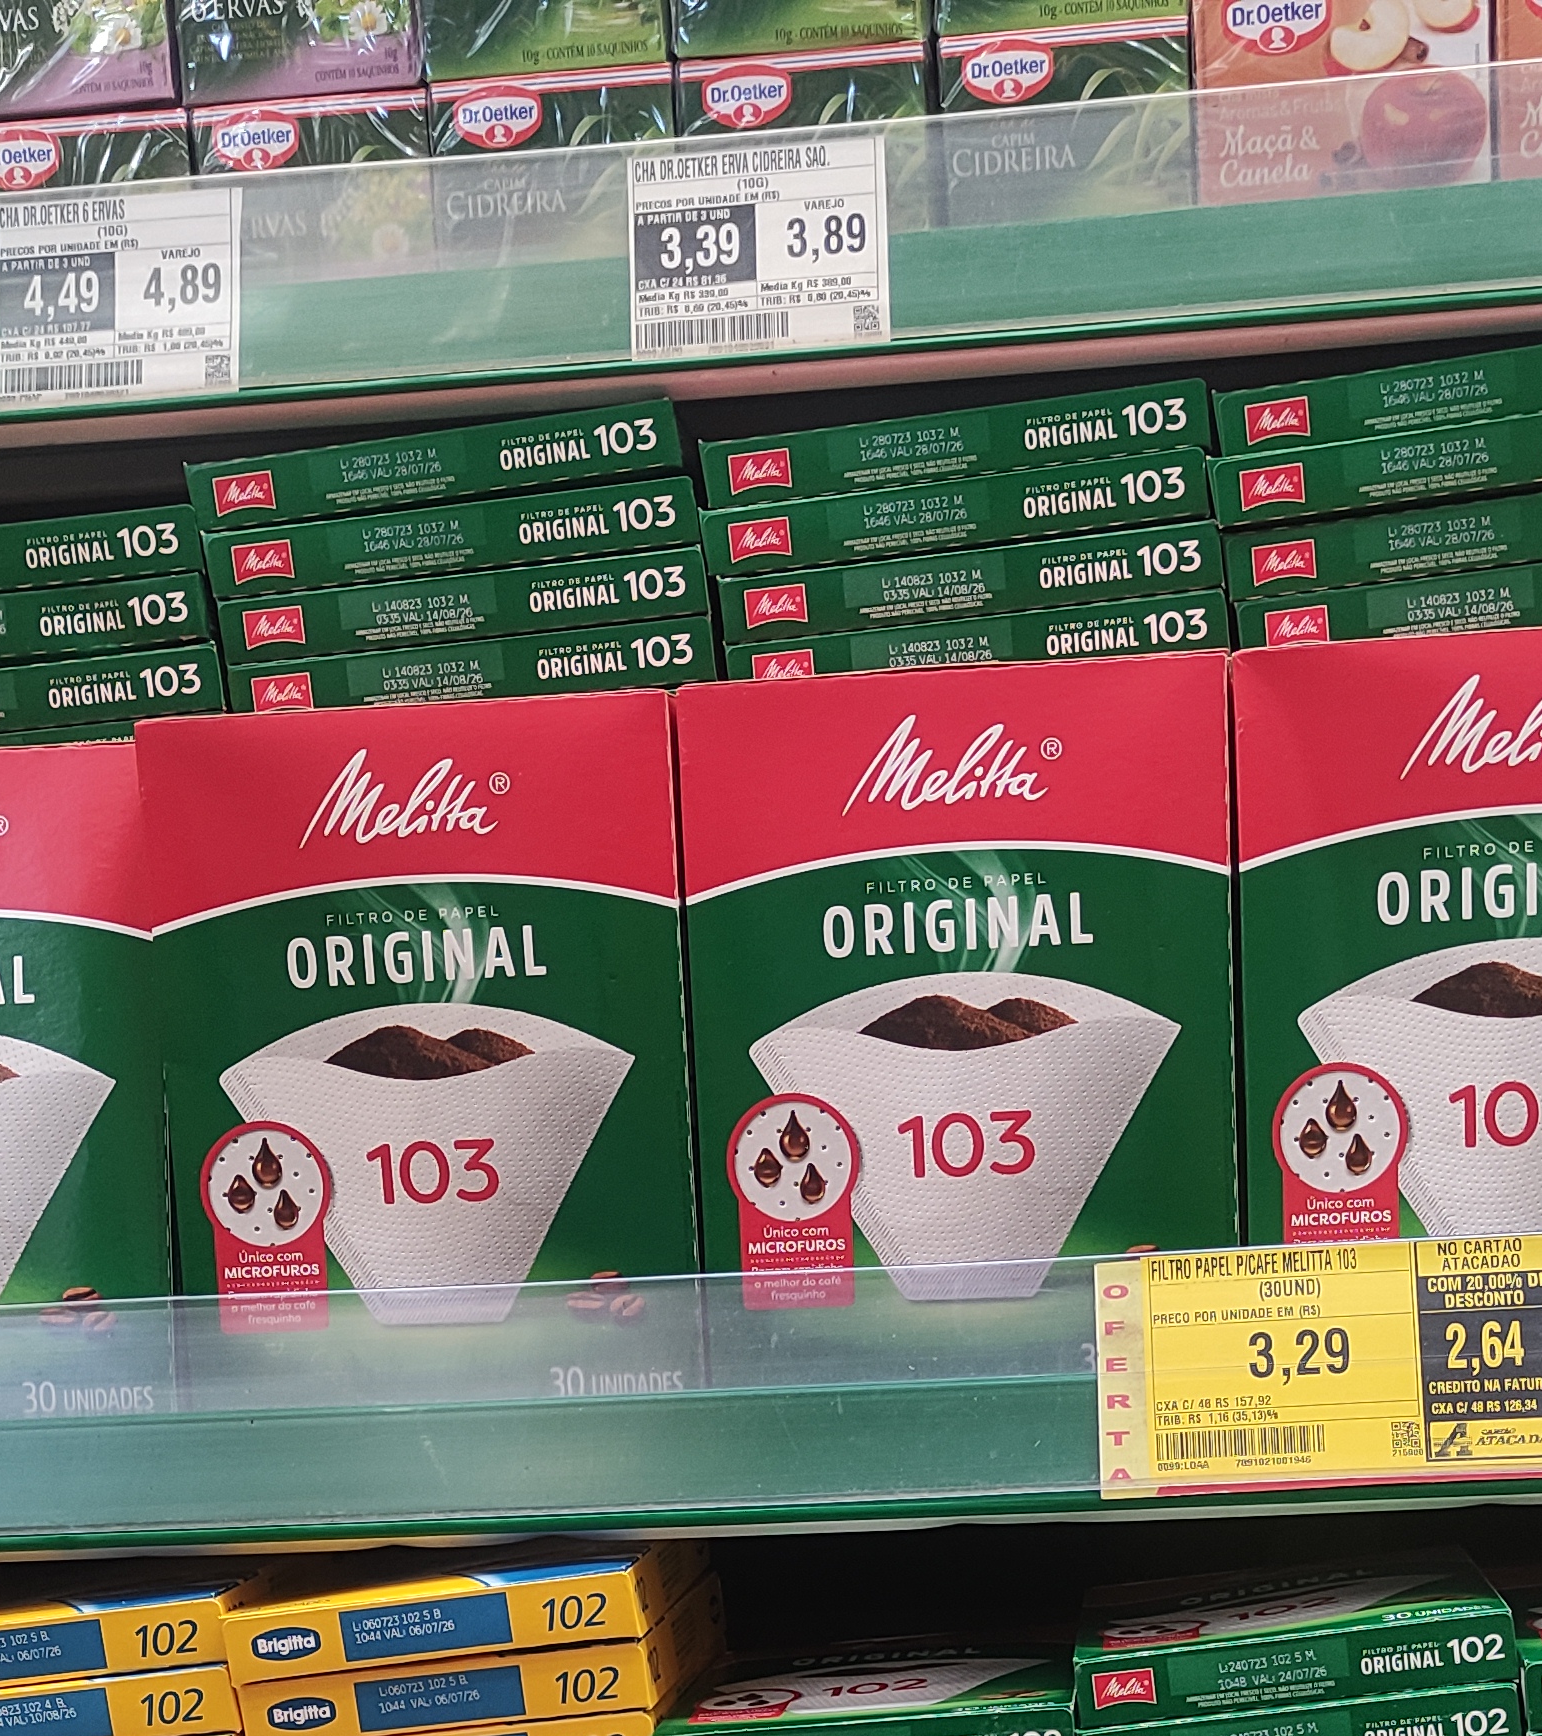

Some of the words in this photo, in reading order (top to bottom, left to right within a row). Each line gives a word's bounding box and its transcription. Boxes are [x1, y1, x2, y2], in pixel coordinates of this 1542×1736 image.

[1219, 125, 1297, 158] Maçã
[635, 160, 656, 182] CHA
[660, 155, 718, 180] DR.OETKER
[722, 152, 749, 174] ERVA
[752, 148, 801, 172] CIDREIRA
[1219, 159, 1311, 189] Canela
[0, 208, 19, 228] CHA
[23, 203, 79, 226] DR.OETKER
[82, 202, 89, 222] 6
[93, 199, 125, 220] ERVAS
[661, 222, 739, 274] 3,39
[787, 213, 866, 263] 3,89
[24, 271, 99, 322] 4,49
[143, 263, 221, 313] 4,89
[25, 540, 115, 570] ORIGINAL
[115, 522, 179, 558] 103
[841, 714, 1049, 817] Melitta
[299, 748, 498, 850] Melitta
[822, 892, 1095, 960] ORIGINAL
[285, 926, 547, 990] ORIGINAL
[899, 1110, 1037, 1180] 103
[366, 1138, 501, 1206] 103
[1152, 1258, 1191, 1281] FILTRO
[1196, 1255, 1232, 1277] PAPEL
[1236, 1253, 1278, 1275] P/CAFE
[1283, 1250, 1332, 1272] MELITTA
[1337, 1249, 1357, 1270] 103
[1437, 1243, 1457, 1255] NO
[1464, 1239, 1522, 1255] CARTAO
[1442, 1255, 1521, 1271] ATACADAO
[1259, 1279, 1321, 1301] (30UND)
[1428, 1277, 1461, 1292] COM
[1466, 1274, 1522, 1292] 20,00%
[1444, 1290, 1524, 1308] DESCONTO
[1195, 1311, 1217, 1323] POR
[1221, 1308, 1272, 1321] UNIDADE
[1277, 1306, 1294, 1318] EM
[1249, 1327, 1350, 1385] 3,29
[1446, 1320, 1524, 1376] 2,64
[1102, 1284, 1132, 1480] OFERTA
[1235, 1396, 1272, 1408] 157,92
[1429, 1379, 1481, 1395] CREDITO
[1484, 1379, 1500, 1392] NA
[256, 1634, 317, 1656] Brigitta
